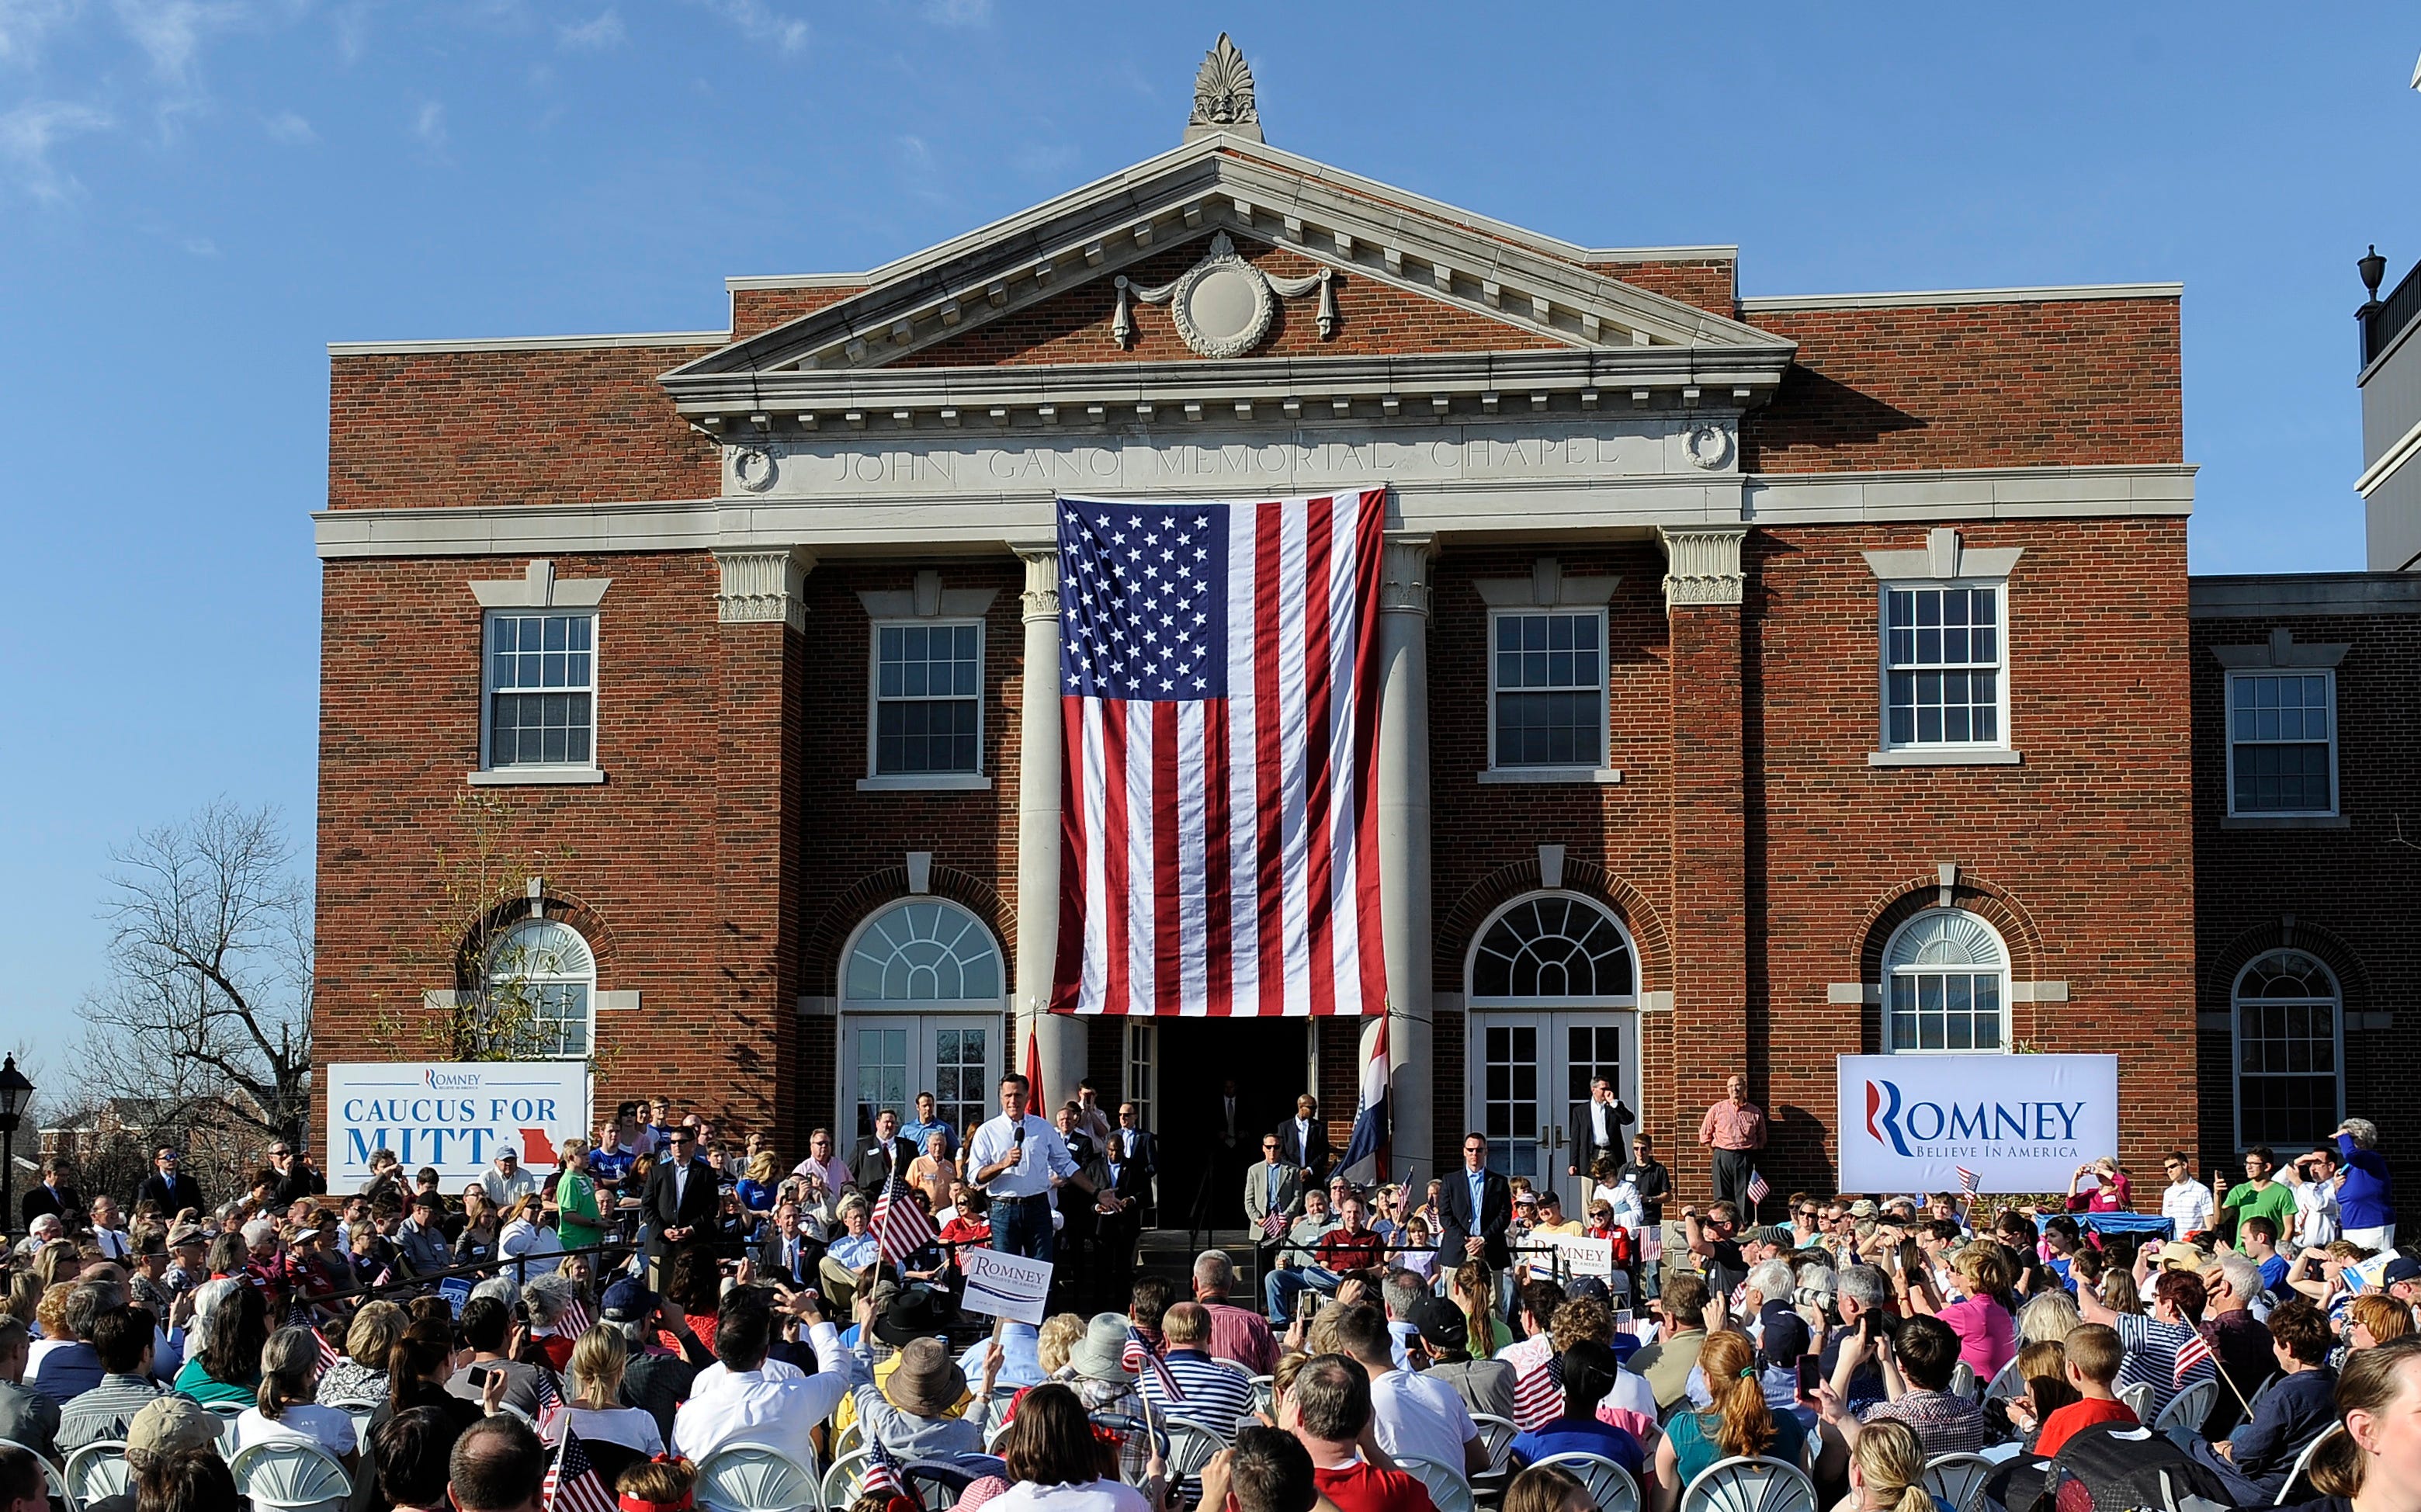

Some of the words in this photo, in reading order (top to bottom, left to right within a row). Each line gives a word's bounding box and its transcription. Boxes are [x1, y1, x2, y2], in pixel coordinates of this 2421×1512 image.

[834, 451, 952, 482] JOHN
[989, 446, 1120, 478] GANO
[1156, 441, 1396, 474] MEMORIAL
[1431, 434, 1621, 467] CHAPEL
[425, 1068, 481, 1090] ROMNEY
[344, 1098, 475, 1122] CAUCUS
[489, 1098, 557, 1122] FOR
[1866, 1080, 2086, 1157] ROMNEY
[344, 1127, 494, 1165] MITT
[1916, 1146, 1978, 1158] BELIEVE
[1985, 1146, 2002, 1158] IN
[2007, 1145, 2079, 1157] AMERICA
[974, 1256, 1045, 1284] ROMNEY
